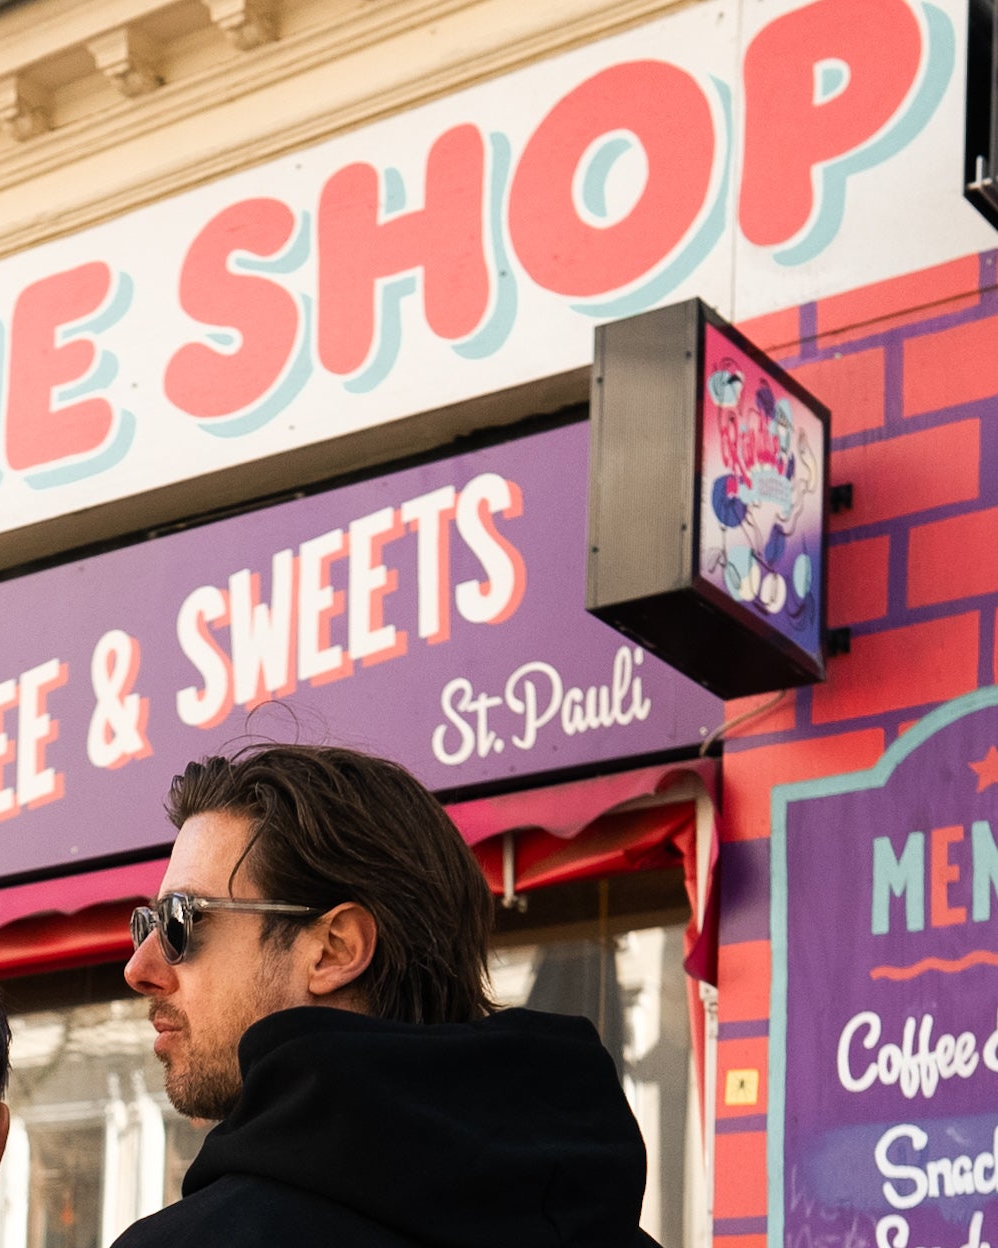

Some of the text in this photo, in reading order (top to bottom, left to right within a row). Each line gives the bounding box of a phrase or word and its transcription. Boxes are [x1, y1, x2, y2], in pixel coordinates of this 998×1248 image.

[163, 0, 955, 439] SHOP
[87, 629, 153, 770] &
[176, 472, 526, 726] SWEETS
[837, 1010, 979, 1099] Coffee
[874, 1123, 998, 1210] Snac
